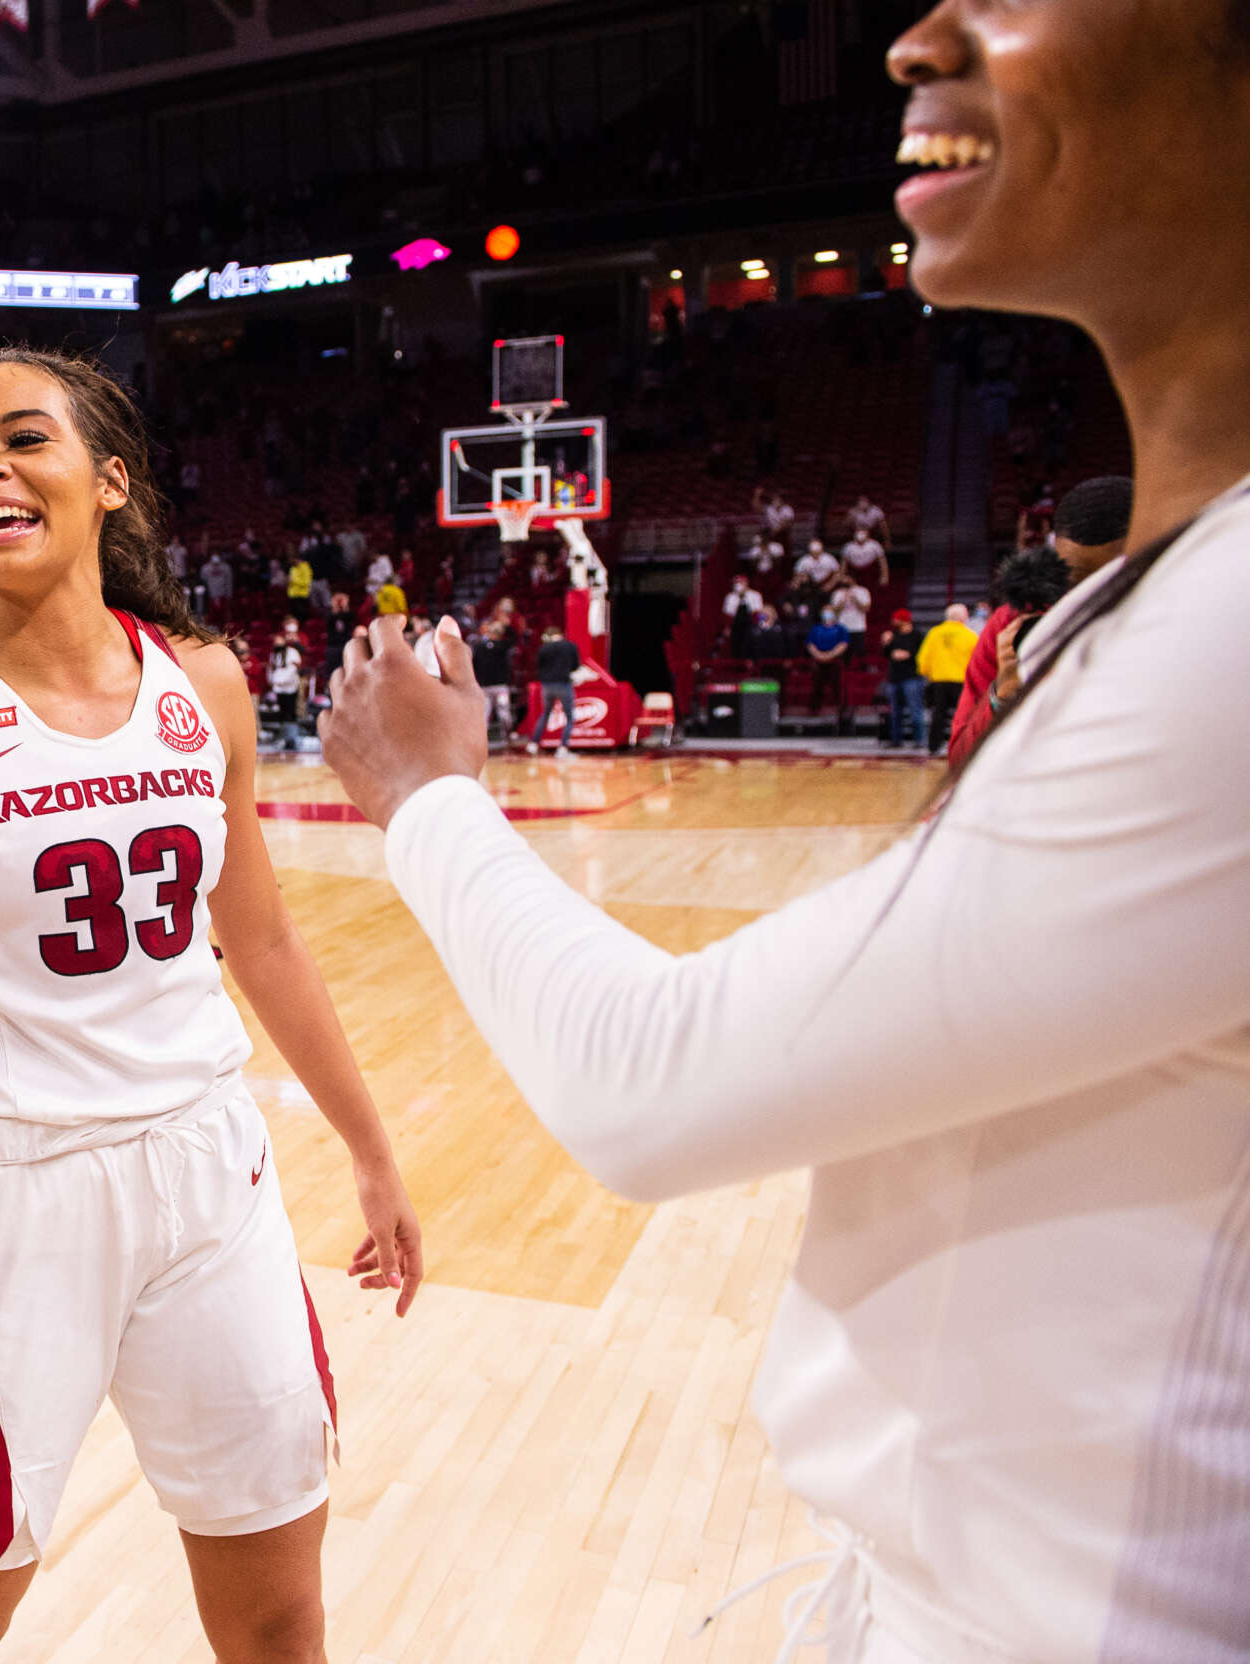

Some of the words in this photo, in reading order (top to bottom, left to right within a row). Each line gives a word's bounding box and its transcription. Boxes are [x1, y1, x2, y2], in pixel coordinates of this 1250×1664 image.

[161, 695, 196, 735] SEC
[167, 735, 204, 752] GRADUATE
[33, 824, 203, 976] 33
